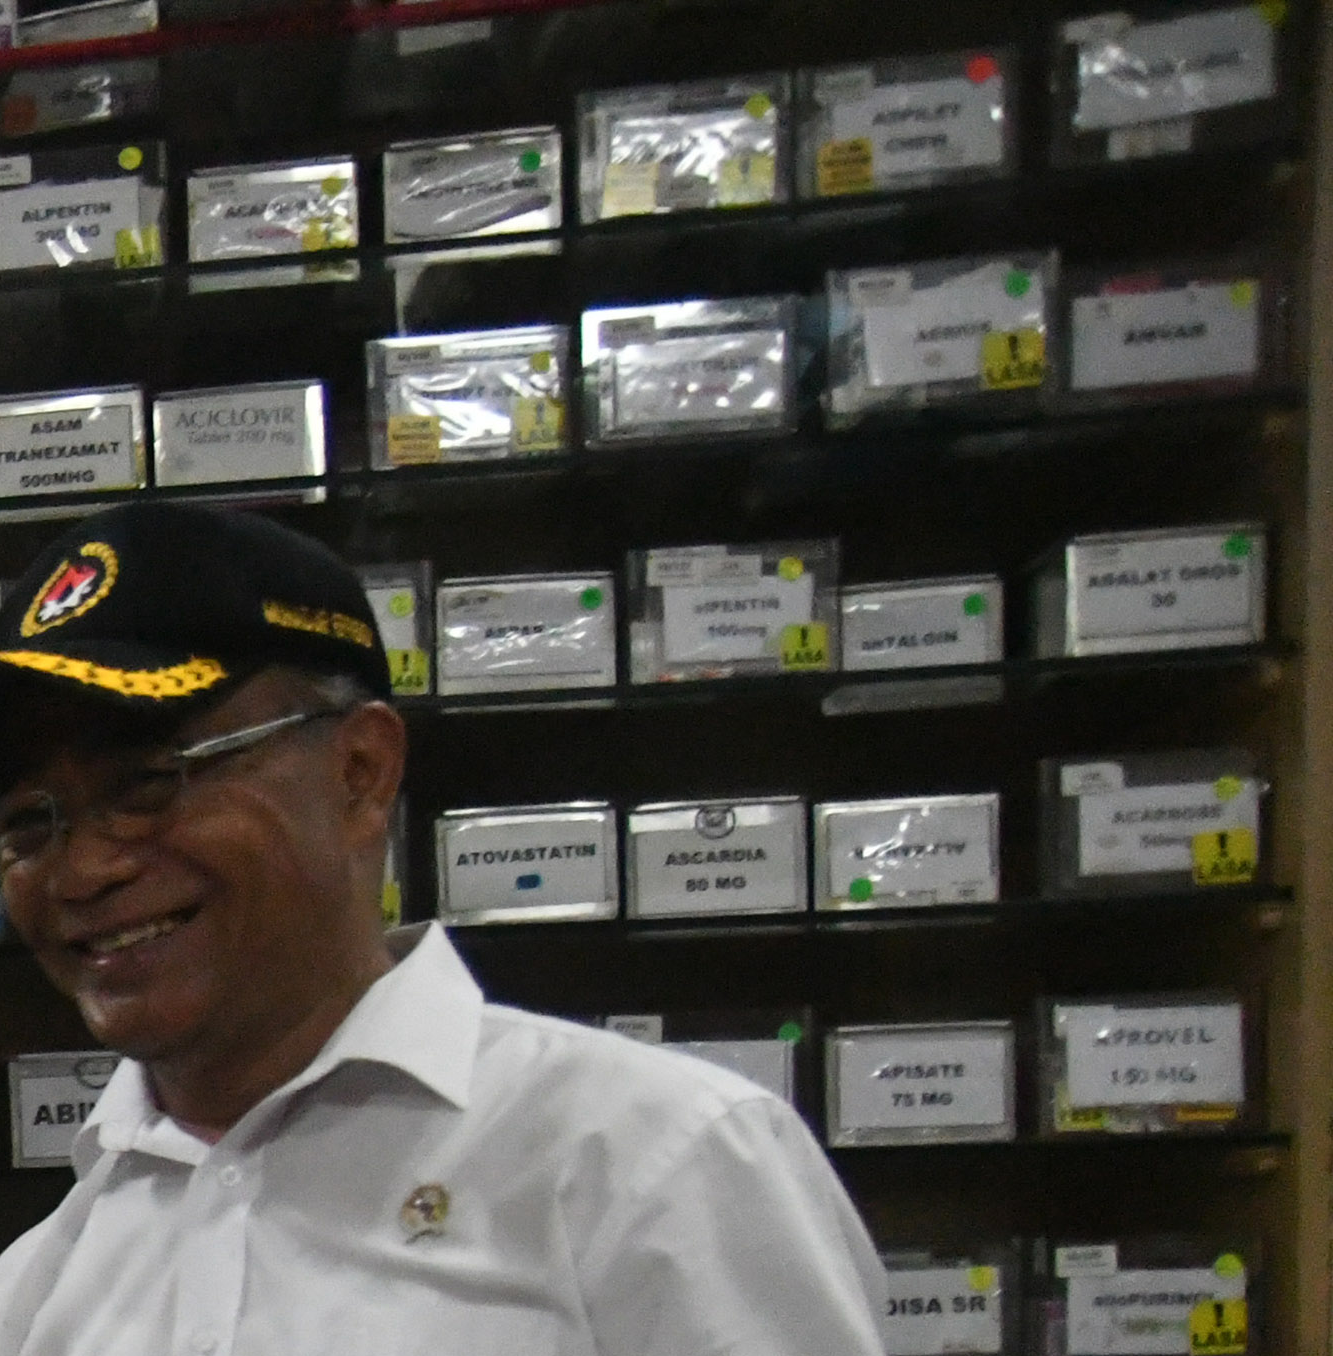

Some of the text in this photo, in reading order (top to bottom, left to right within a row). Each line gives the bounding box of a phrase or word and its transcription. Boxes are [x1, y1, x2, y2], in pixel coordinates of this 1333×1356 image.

[21, 201, 112, 224] ALPENTIN
[30, 417, 83, 436] ASAM
[175, 406, 296, 429] ACICLOVIR
[456, 842, 597, 867] ATOVASTATIN
[664, 845, 769, 867] ASCARDIA
[714, 874, 747, 890] MG
[920, 1091, 953, 1107] MG
[33, 1103, 95, 1127] ABI
[952, 1294, 987, 1312] SR
